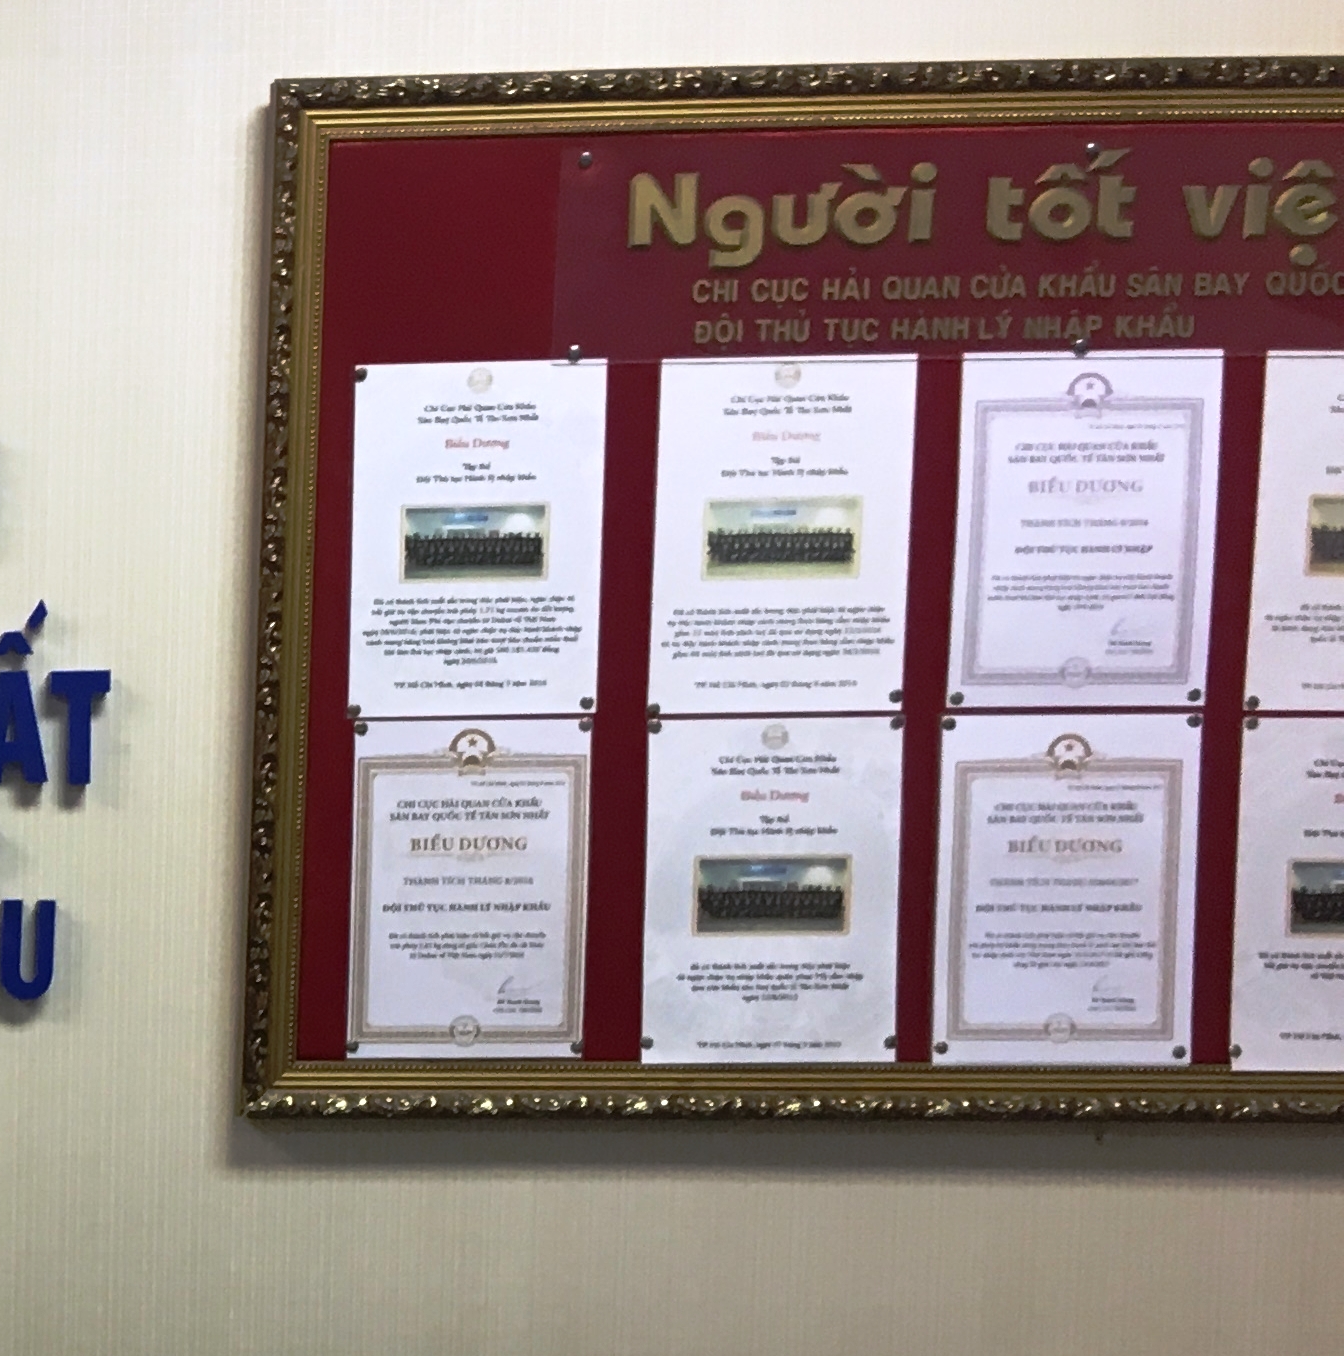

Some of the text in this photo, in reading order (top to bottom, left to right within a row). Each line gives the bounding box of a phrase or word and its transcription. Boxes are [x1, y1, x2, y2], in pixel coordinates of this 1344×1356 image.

[628, 162, 938, 269] Người
[986, 147, 1138, 241] tốt
[692, 278, 739, 304] CHI
[752, 276, 809, 308] CỤC
[822, 267, 871, 302] HẢI
[882, 274, 961, 303] QUAN
[970, 264, 1026, 299] CỬA
[1038, 260, 1116, 298] KHẨU
[1126, 264, 1183, 298] SÂN
[1193, 272, 1250, 297] BAY
[694, 302, 1196, 350] ĐỘI THỦ TỤC HÀNH LÝ NHẬP KHẨU
